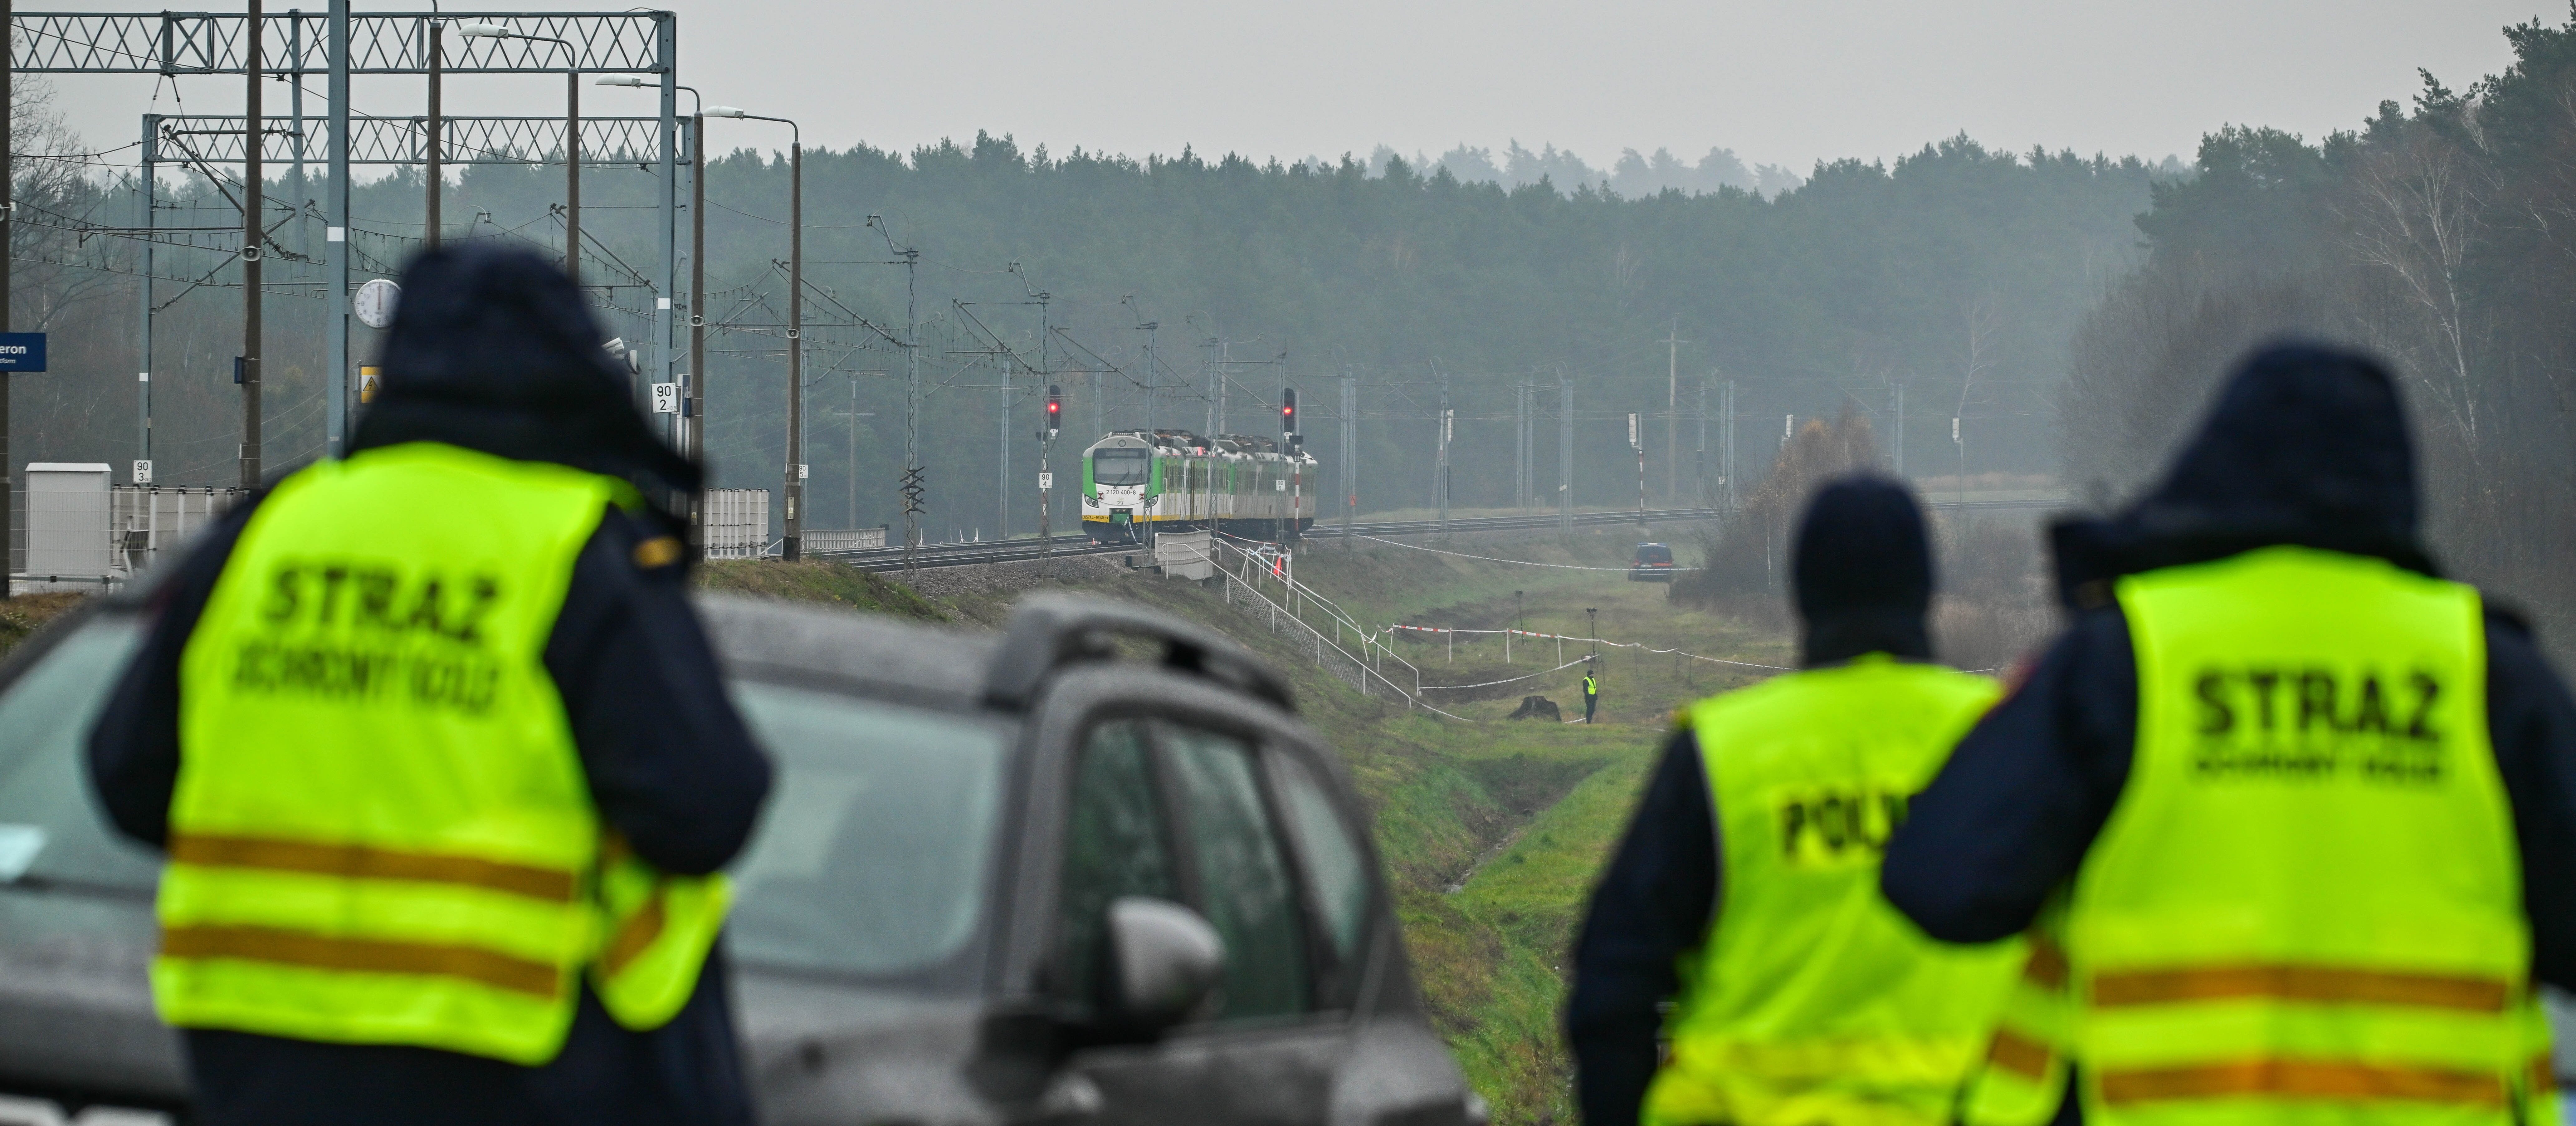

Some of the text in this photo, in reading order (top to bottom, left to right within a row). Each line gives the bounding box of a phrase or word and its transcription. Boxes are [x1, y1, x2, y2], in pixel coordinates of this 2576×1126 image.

[657, 385, 671, 397] 90
[660, 399, 666, 410] 2
[137, 462, 148, 471] 90
[139, 472, 144, 481] 3
